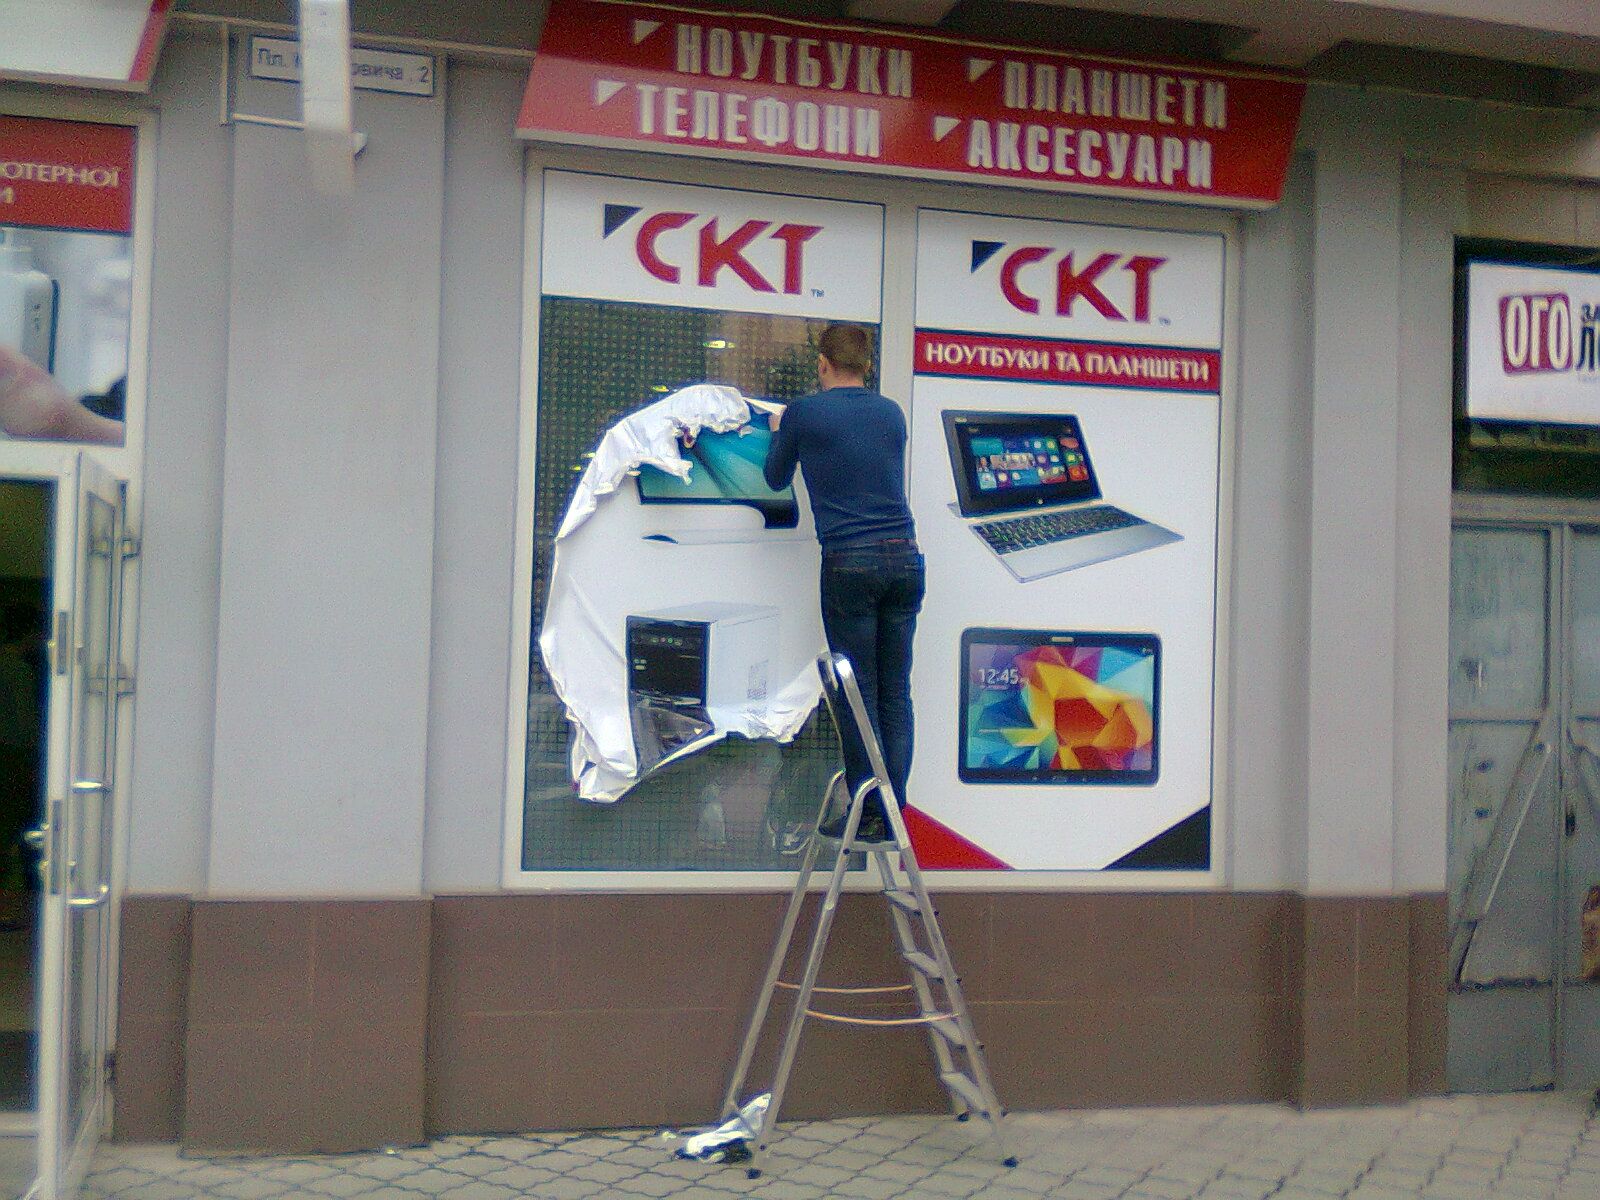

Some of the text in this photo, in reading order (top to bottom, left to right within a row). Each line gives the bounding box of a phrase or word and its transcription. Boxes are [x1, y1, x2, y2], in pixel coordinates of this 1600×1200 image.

[417, 65, 428, 83] 2
[676, 23, 913, 98] НОУТБУКИ
[1004, 60, 1228, 129] ПЛАНШЕТИ
[636, 84, 880, 158] ТЕЛЕФОНИ
[967, 119, 1212, 189] АКСЕСУАРИ
[635, 211, 825, 295] СКТ
[1000, 246, 1168, 323] СКТ
[925, 341, 1210, 382] НОУТБУКИ ТА ПЛАНШЕТИ
[1505, 297, 1571, 370] ОГО
[978, 668, 1019, 685] 12:45
